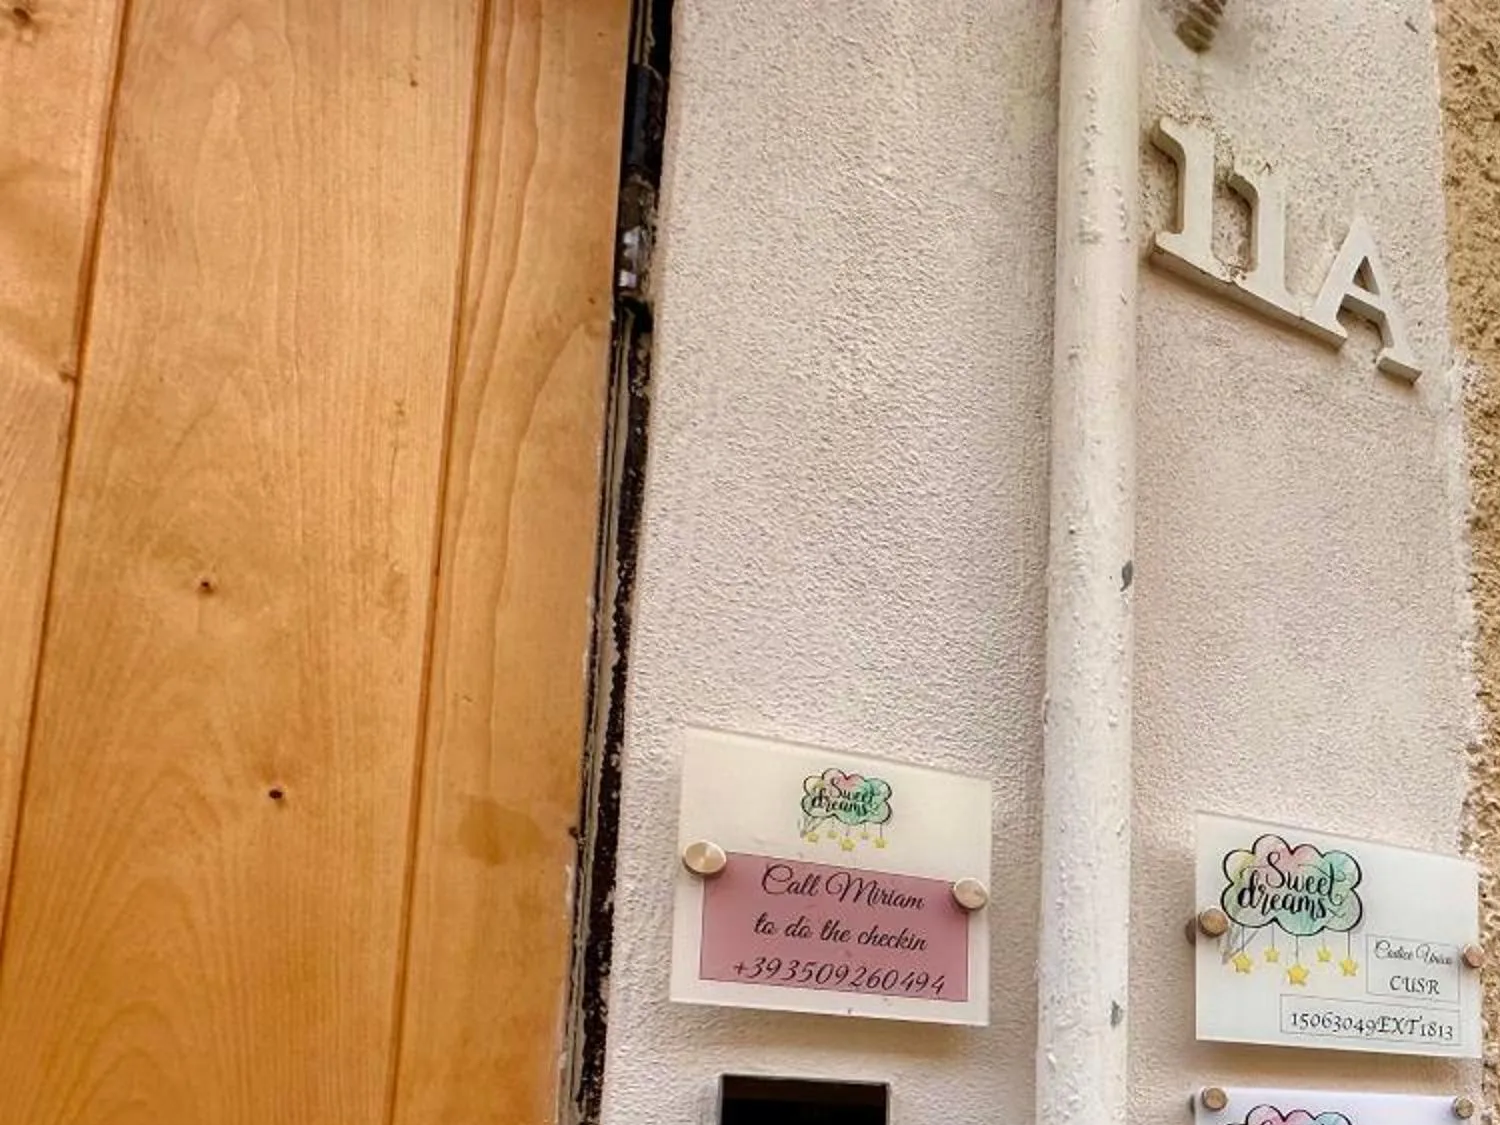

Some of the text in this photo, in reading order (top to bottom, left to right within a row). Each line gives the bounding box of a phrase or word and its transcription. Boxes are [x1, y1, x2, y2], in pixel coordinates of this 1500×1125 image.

[1150, 113, 1422, 378] 11A
[761, 863, 926, 911] Call Miriam
[1237, 868, 1330, 920] dreams
[1264, 851, 1345, 906] Sweet
[752, 912, 928, 952] to do the checkin
[1389, 975, 1440, 995] CUSR
[1290, 1010, 1454, 1041] 15063049EXT1813
